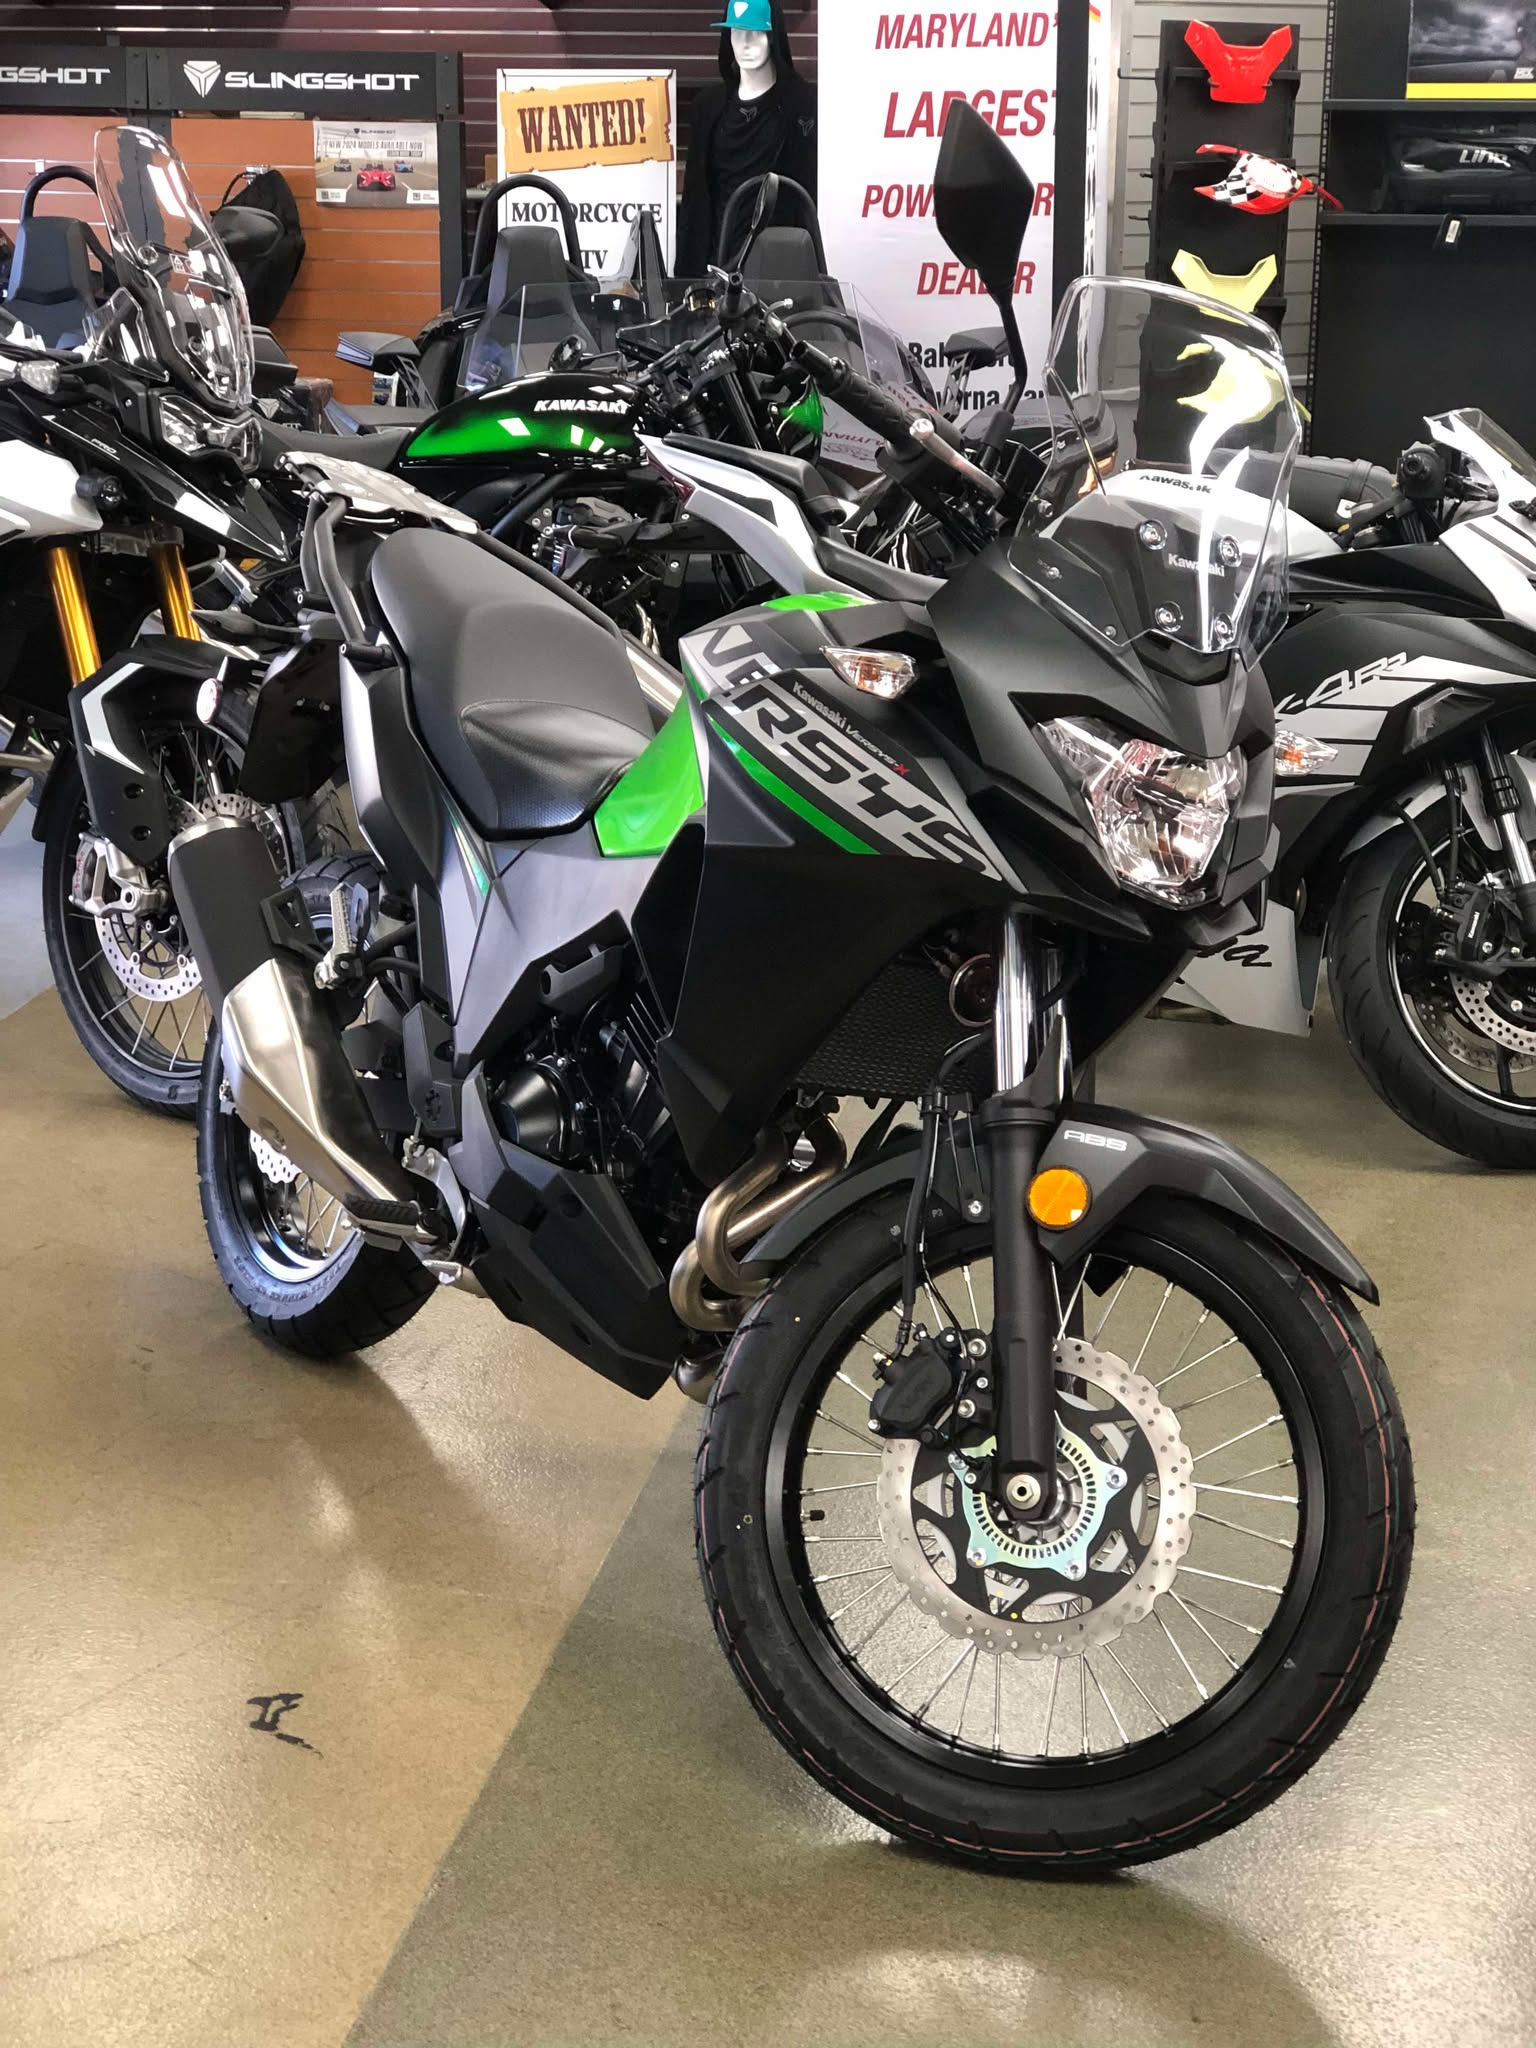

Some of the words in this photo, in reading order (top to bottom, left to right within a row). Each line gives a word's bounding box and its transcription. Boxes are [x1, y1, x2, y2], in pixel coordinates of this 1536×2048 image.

[225, 71, 420, 91] SLINGSHOT
[517, 98, 647, 154] WANTED!
[883, 89, 1057, 138] LAGES
[511, 202, 662, 223] MOTORCYCE
[916, 262, 1036, 295] DEAR
[533, 399, 629, 415] KAWASAKI
[1168, 553, 1225, 577] Kawaki
[792, 681, 848, 729] Kawasaki
